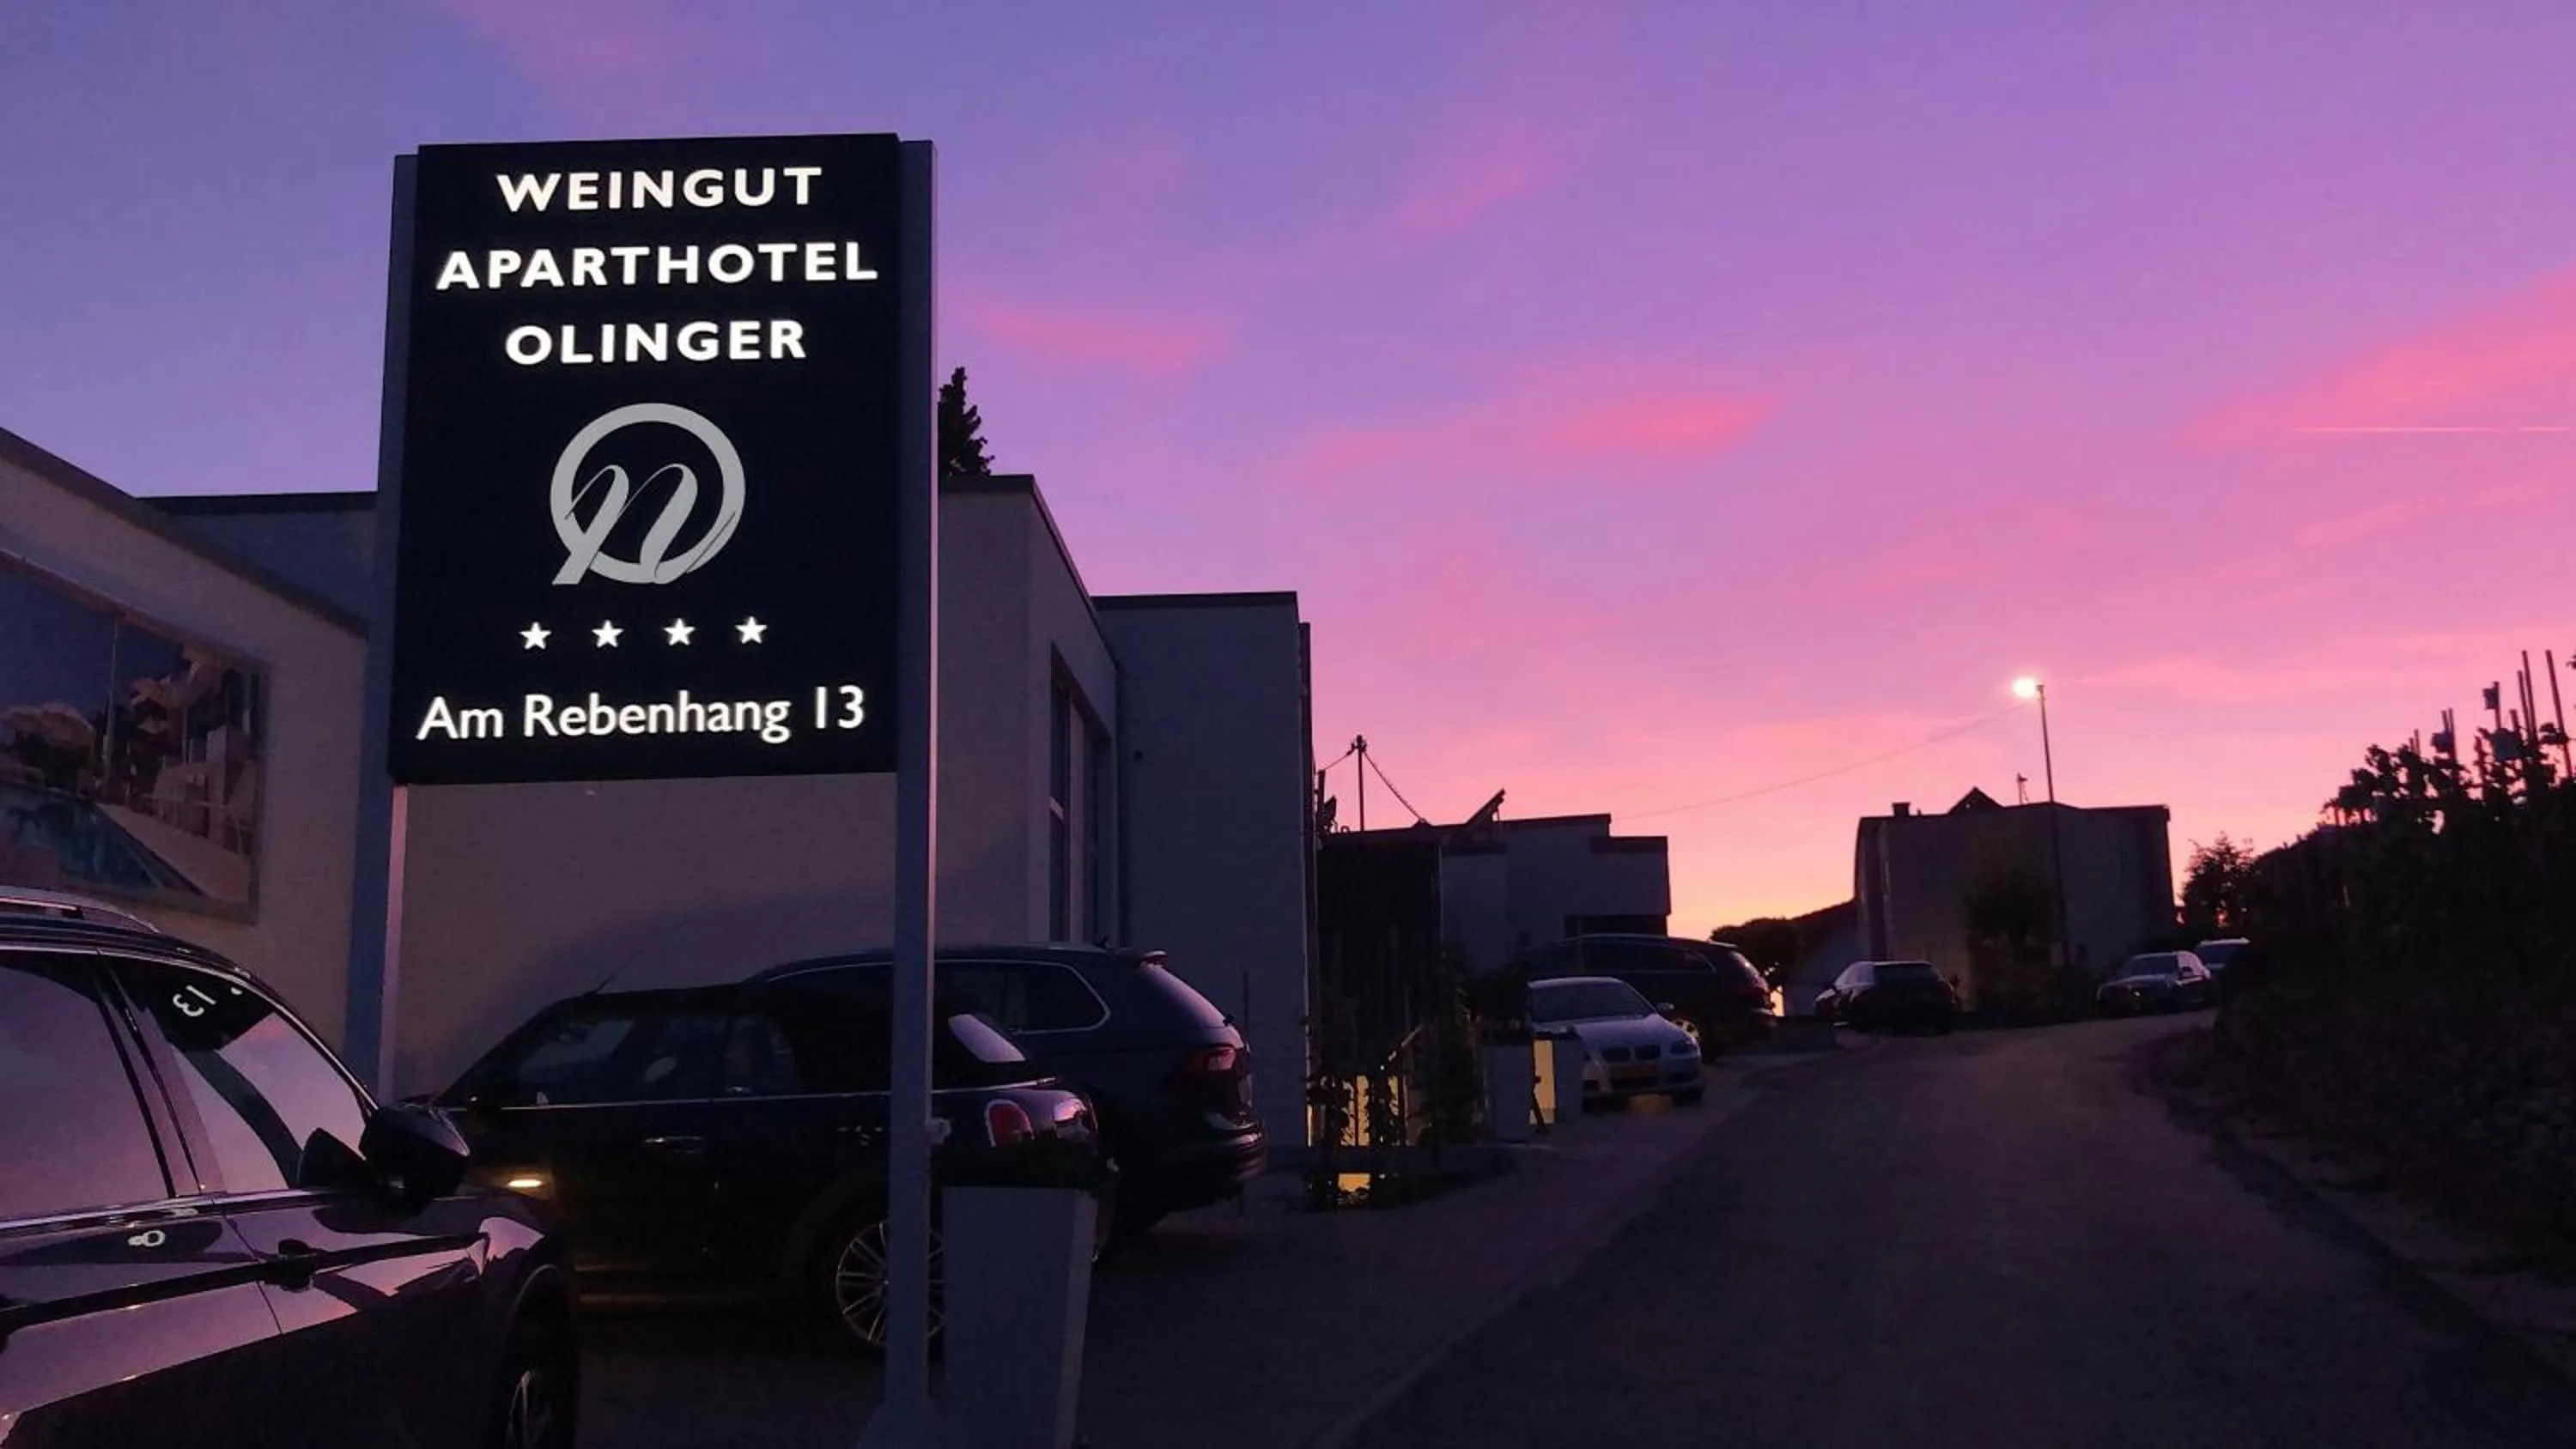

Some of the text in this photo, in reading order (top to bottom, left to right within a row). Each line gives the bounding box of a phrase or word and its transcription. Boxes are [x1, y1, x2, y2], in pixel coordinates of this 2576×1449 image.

[496, 167, 822, 212] WEINGUT
[435, 241, 878, 291] APARTHOTEL
[505, 319, 806, 365] OLINGER
[416, 683, 866, 744] Am Rebenhang 13
